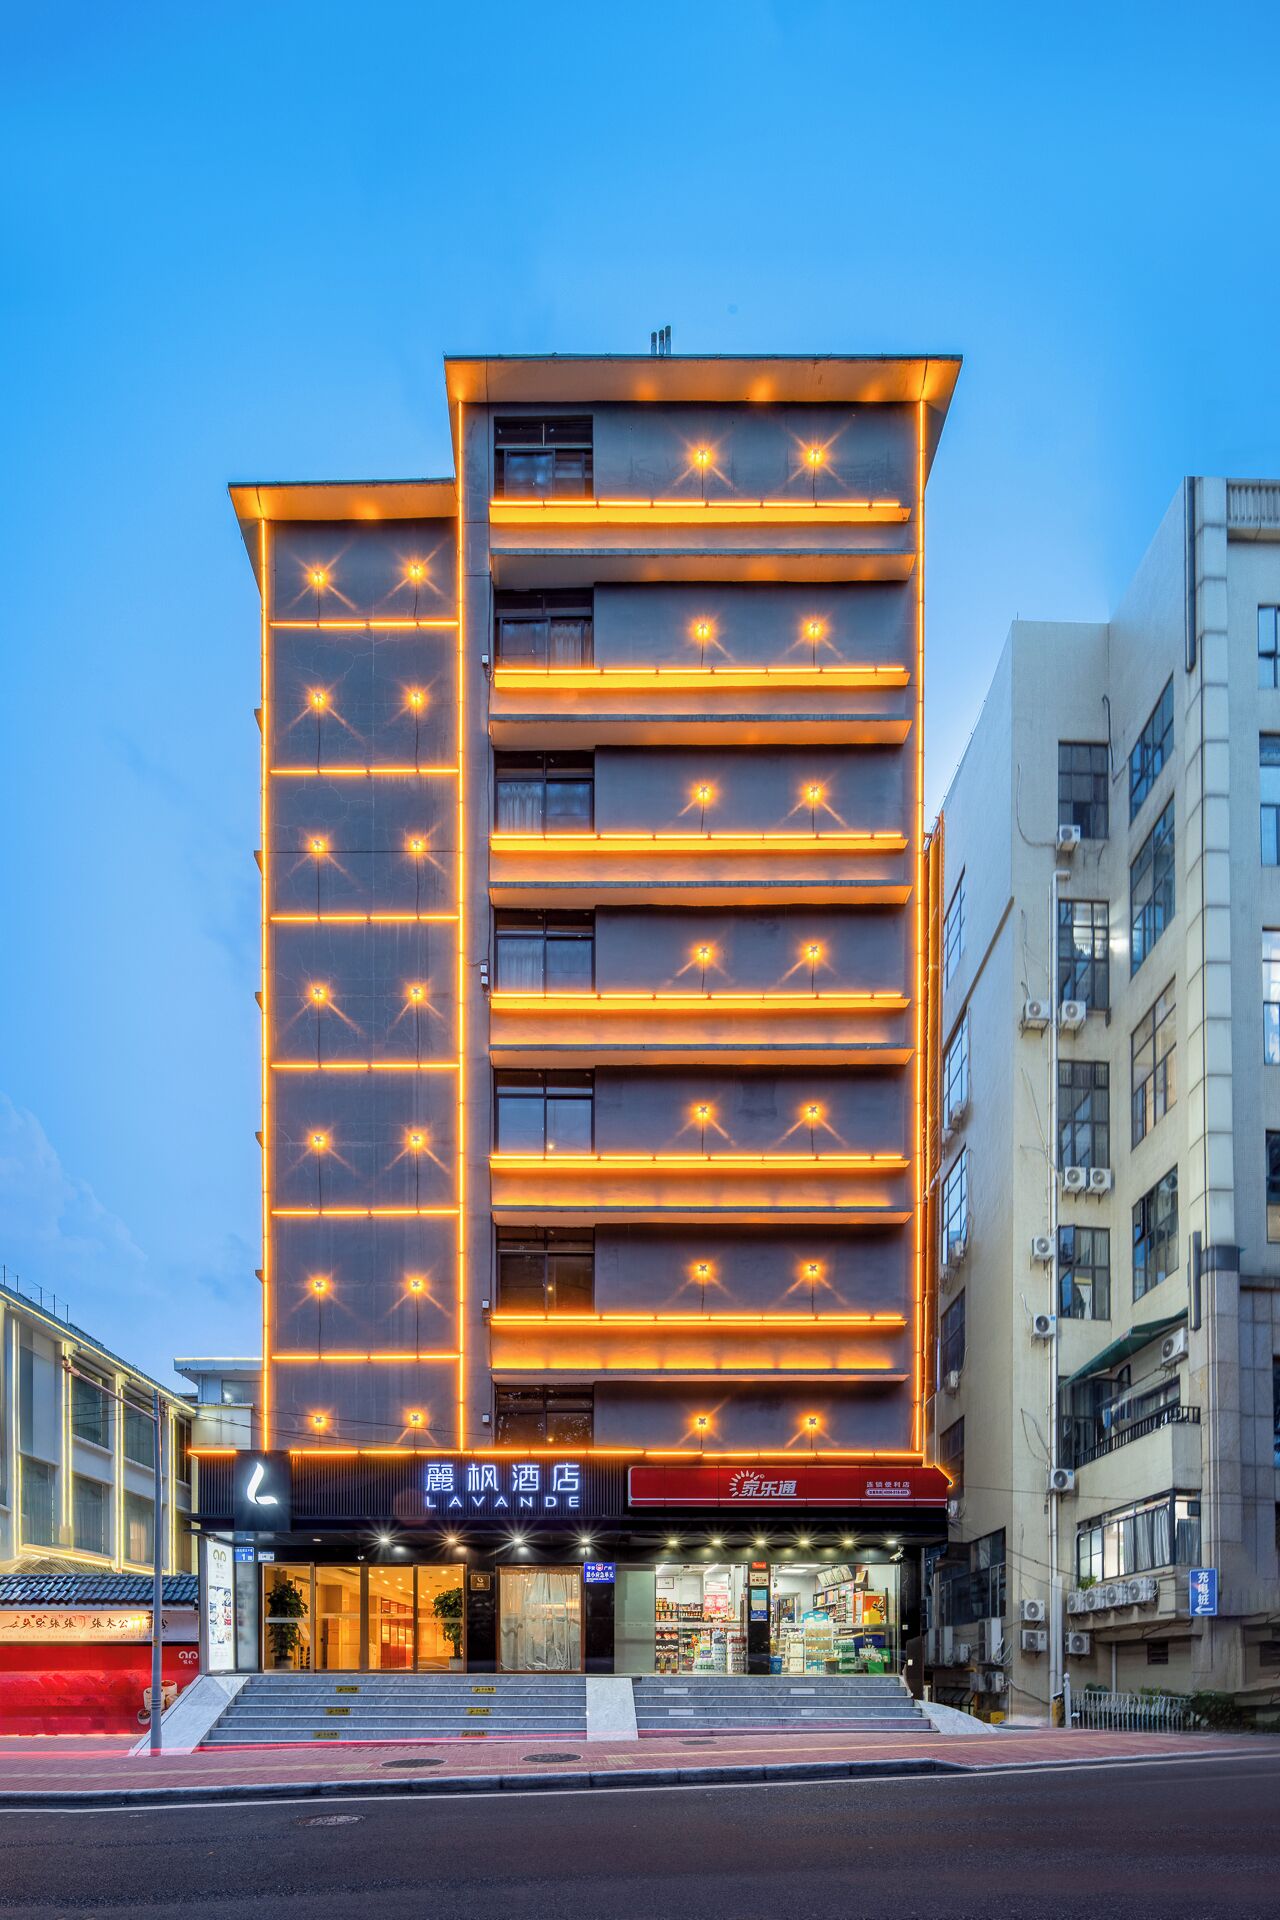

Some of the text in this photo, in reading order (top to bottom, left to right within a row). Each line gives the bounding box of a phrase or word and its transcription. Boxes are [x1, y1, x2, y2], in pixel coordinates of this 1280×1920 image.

[425, 1463, 580, 1492] 麗枫酒店
[739, 1479, 797, 1497] 家乐通
[426, 1496, 580, 1508] LAVANDE
[1197, 1571, 1209, 1605] 充电桩
